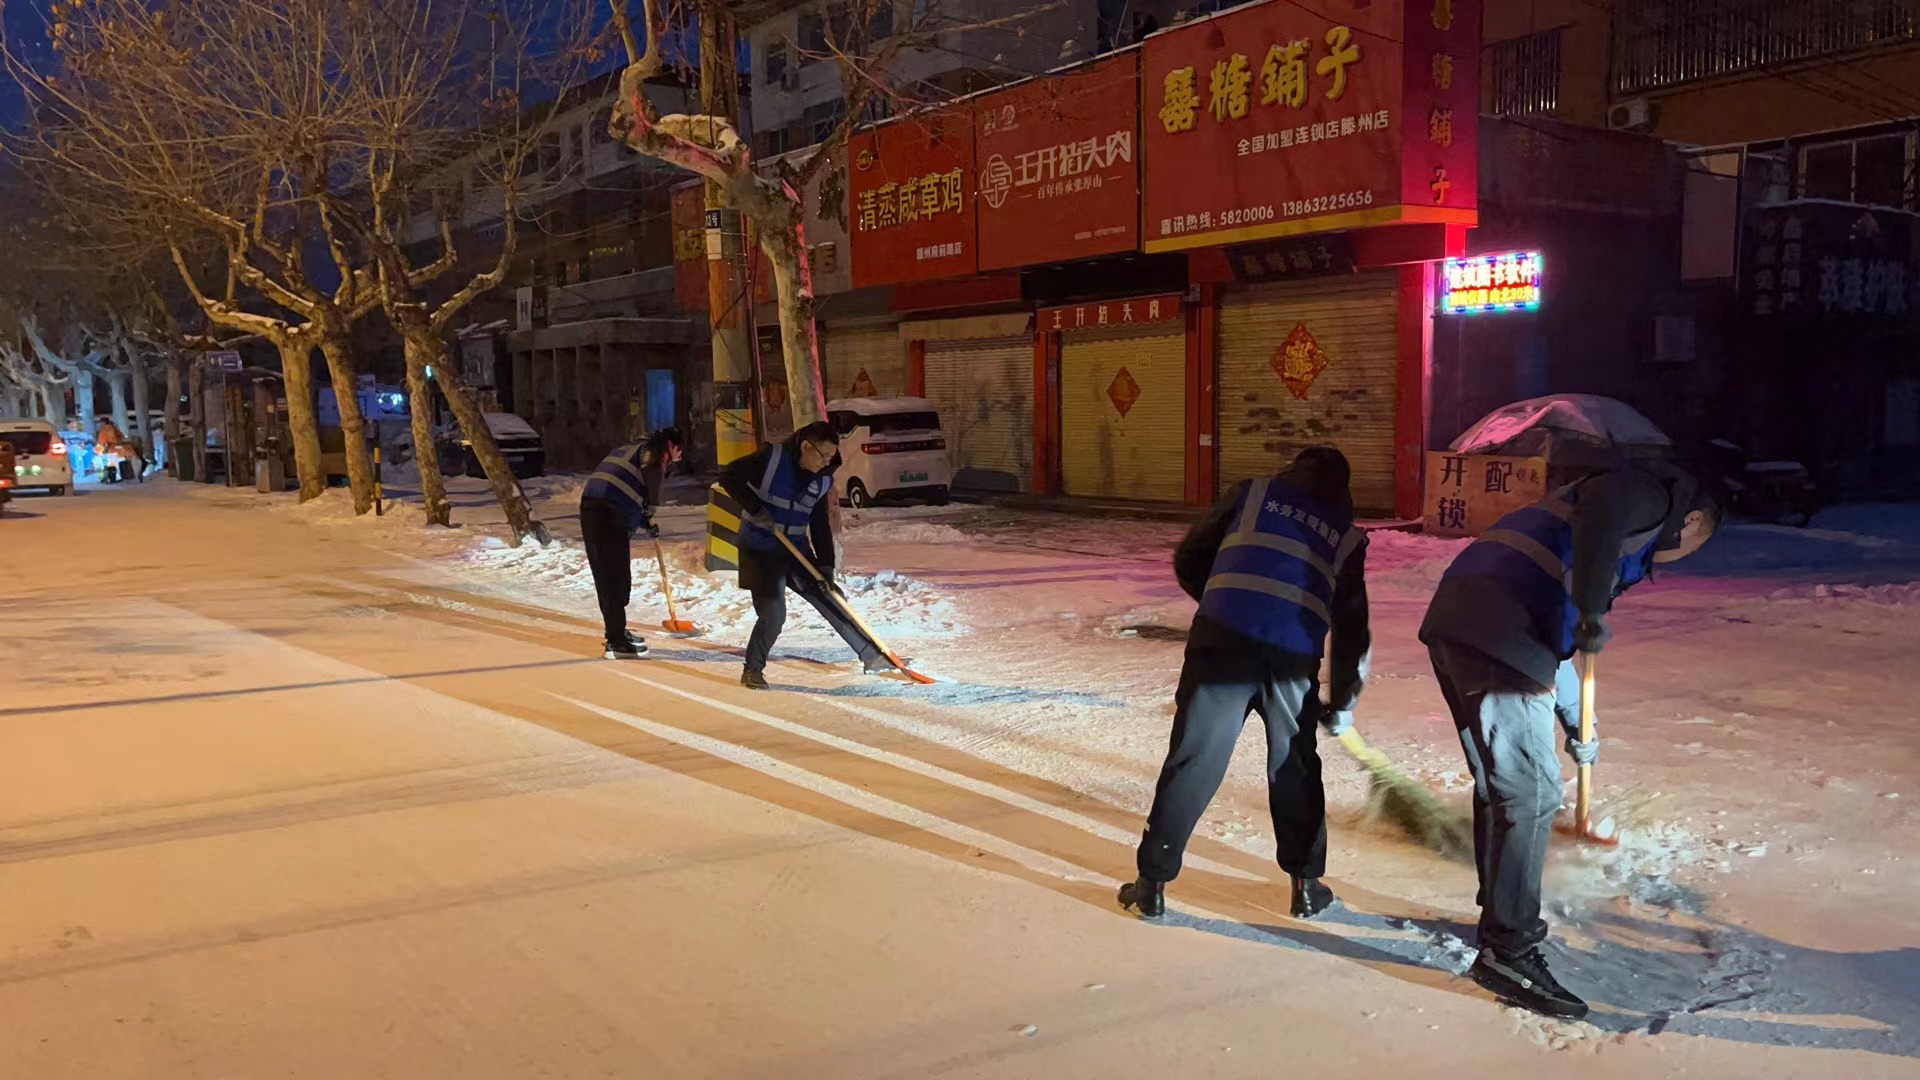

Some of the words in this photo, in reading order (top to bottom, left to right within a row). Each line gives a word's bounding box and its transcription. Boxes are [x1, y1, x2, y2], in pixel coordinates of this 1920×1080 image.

[1237, 110, 1389, 156] 全国加盟连锁店滕州店
[1014, 131, 1131, 187] 王开猪头肉
[859, 167, 964, 231] 清蒸咸草鸡
[1220, 205, 1274, 226] 5820006
[1282, 190, 1373, 217] 13863225656
[1053, 300, 1159, 329] 王开猪头肉
